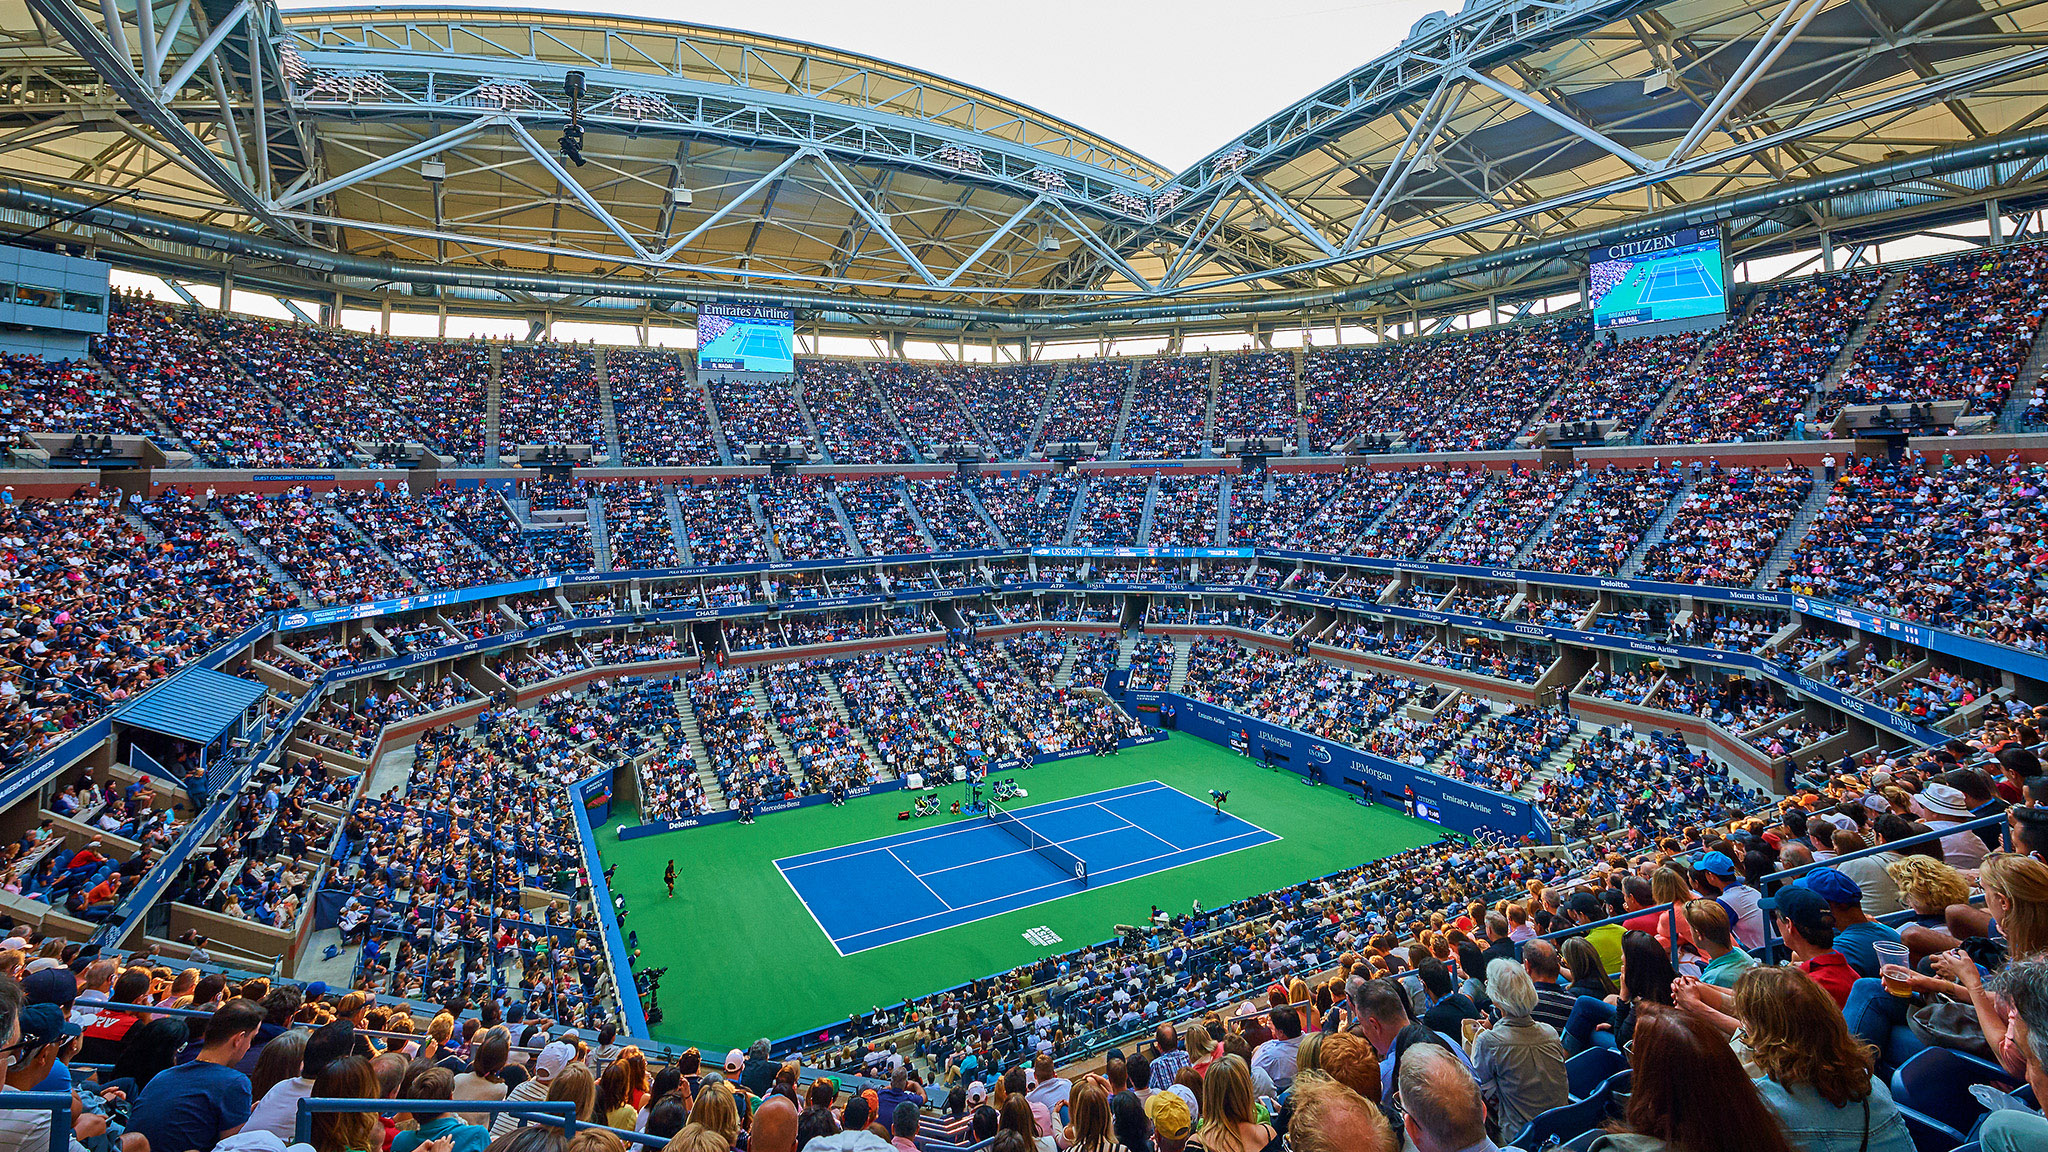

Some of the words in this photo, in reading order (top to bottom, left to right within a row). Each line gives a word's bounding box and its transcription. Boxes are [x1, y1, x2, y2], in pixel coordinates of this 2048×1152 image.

[1699, 228, 1715, 236] 6:11
[1608, 234, 1676, 259] CITIZEN
[704, 304, 751, 316] Emirates
[754, 308, 789, 319] Airline
[1619, 316, 1639, 325] NADAL
[1491, 570, 1516, 578] CHASE
[1600, 580, 1630, 589] Deloitte.
[1729, 591, 1756, 600] Mount
[1757, 593, 1778, 602] Sinai
[360, 609, 384, 618] ANDERSON
[546, 624, 566, 633] Deloitte.
[1514, 625, 1544, 635] CITIZEN
[503, 632, 524, 641] FINALS
[464, 642, 478, 651] evian
[1630, 641, 1656, 651] Emirates
[1657, 645, 1679, 655] Airline
[412, 649, 437, 661] FINALS
[336, 669, 351, 678] POLO
[351, 666, 368, 675] RALPH
[368, 663, 387, 672] LAUREN
[1761, 662, 1779, 676] WESTIN
[1799, 676, 1818, 692] FINALS
[1841, 696, 1865, 714] CHASE
[1890, 714, 1917, 734] FINALS
[1258, 731, 1292, 749] J.P.Morgan
[1314, 750, 1328, 760] OPEN
[31, 758, 55, 780] EXPRESS
[997, 760, 1020, 769] Spectrum
[1350, 761, 1393, 782] J.P.Morgan
[848, 786, 870, 795] WESTIN
[1416, 795, 1438, 806] CITIZEN
[1442, 792, 1469, 807] Emirates
[1470, 800, 1492, 815] Airline
[760, 801, 801, 814] Mercedes-Benz
[1501, 802, 1517, 812] USTA
[668, 819, 699, 830] Deloitte.
[1031, 927, 1057, 945] ASHE
